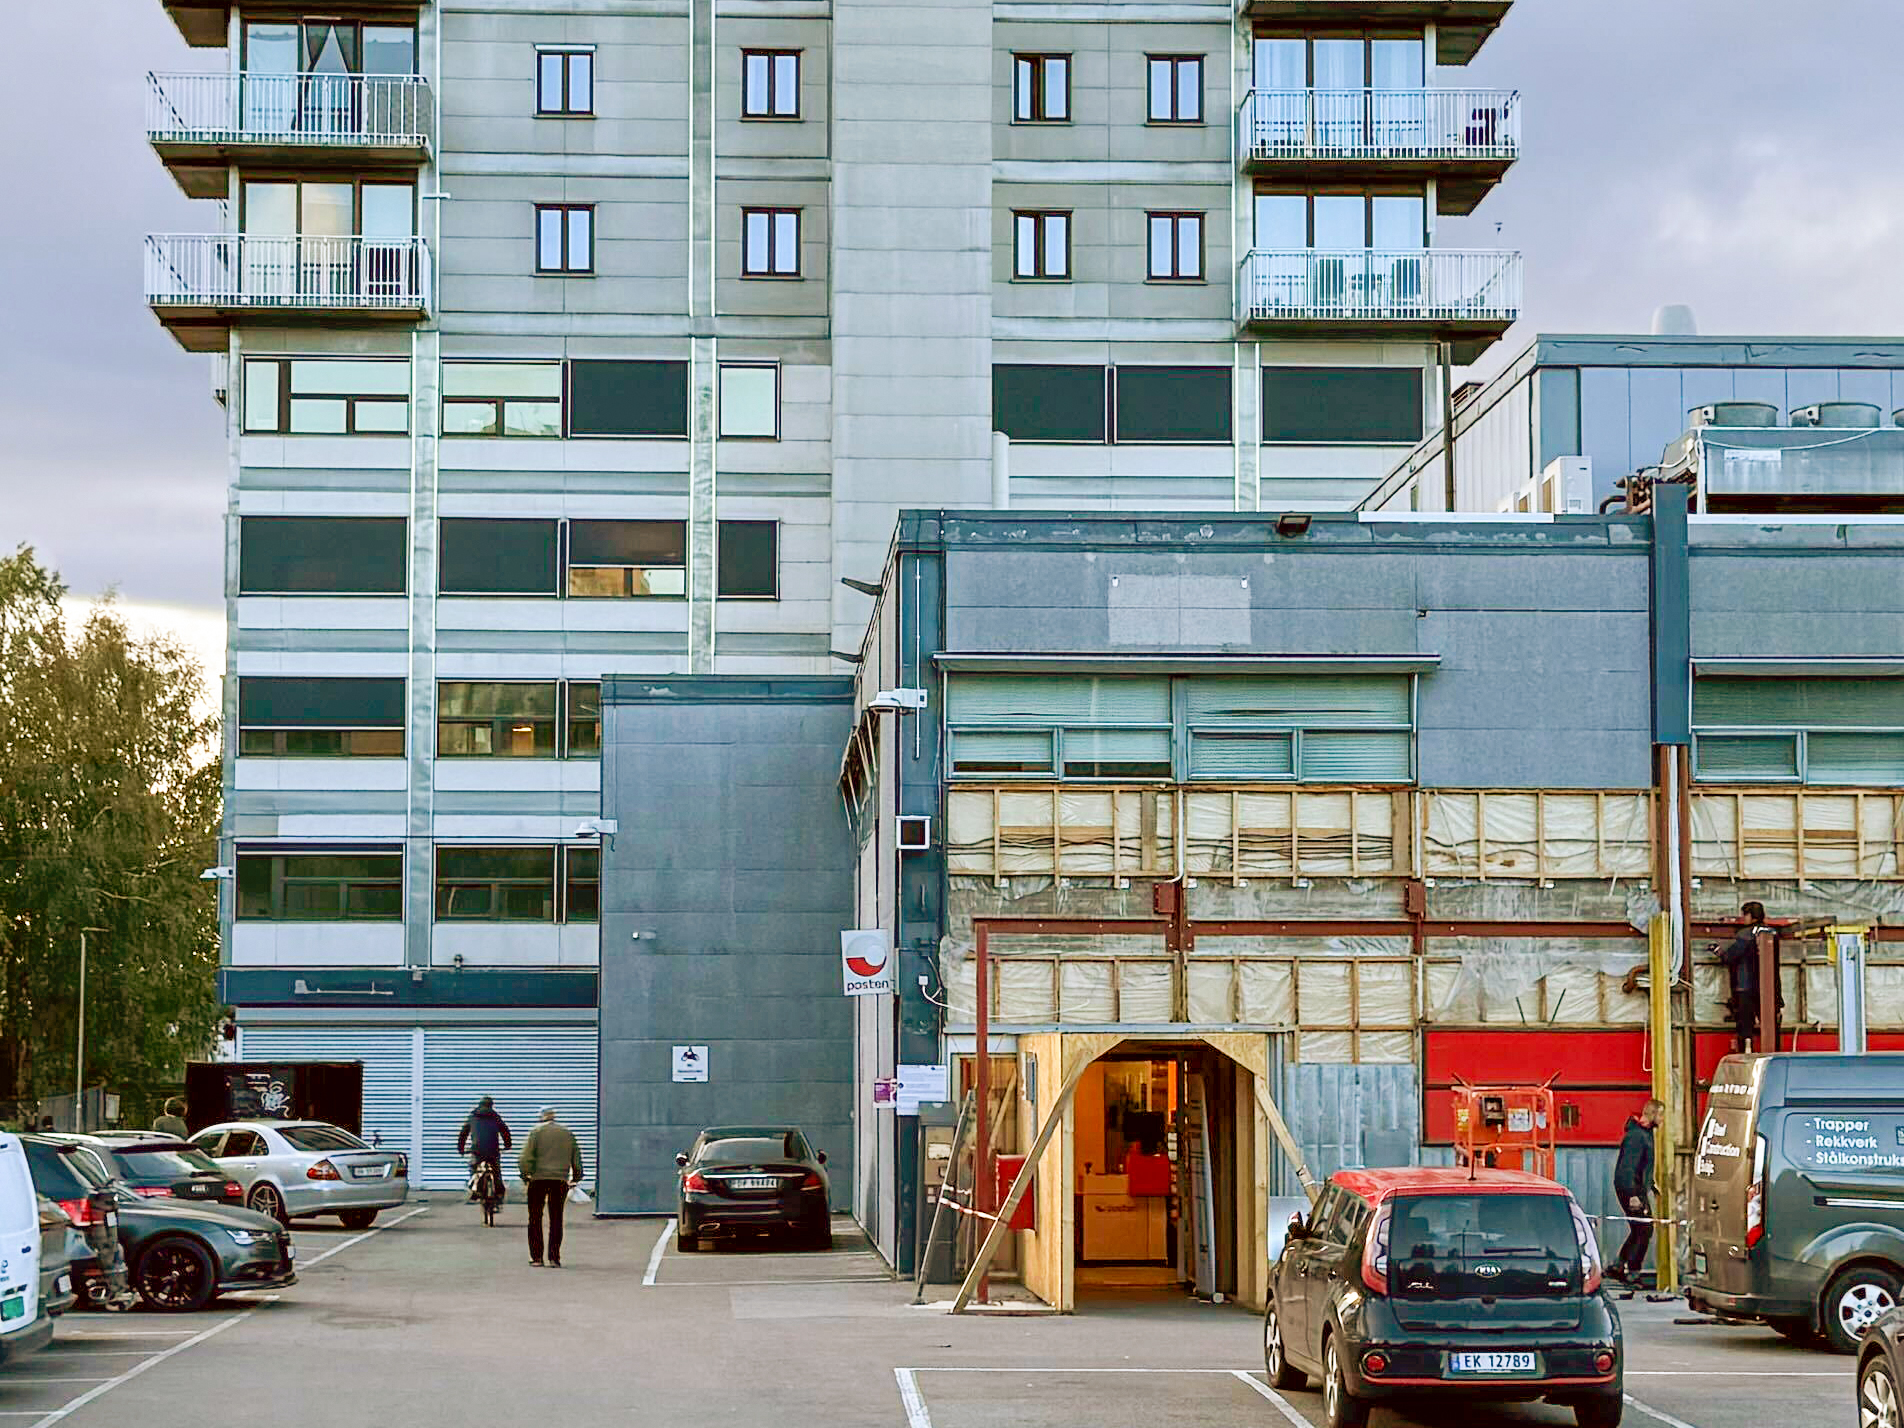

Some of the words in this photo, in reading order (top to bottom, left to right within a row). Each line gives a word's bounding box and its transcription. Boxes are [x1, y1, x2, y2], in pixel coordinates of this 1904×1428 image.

[847, 979, 889, 992] posten
[1814, 1117, 1870, 1133] Trapper
[1815, 1135, 1878, 1149] Rekkverk
[1464, 1355, 1481, 1368] EK
[1490, 1354, 1530, 1368] 12789
